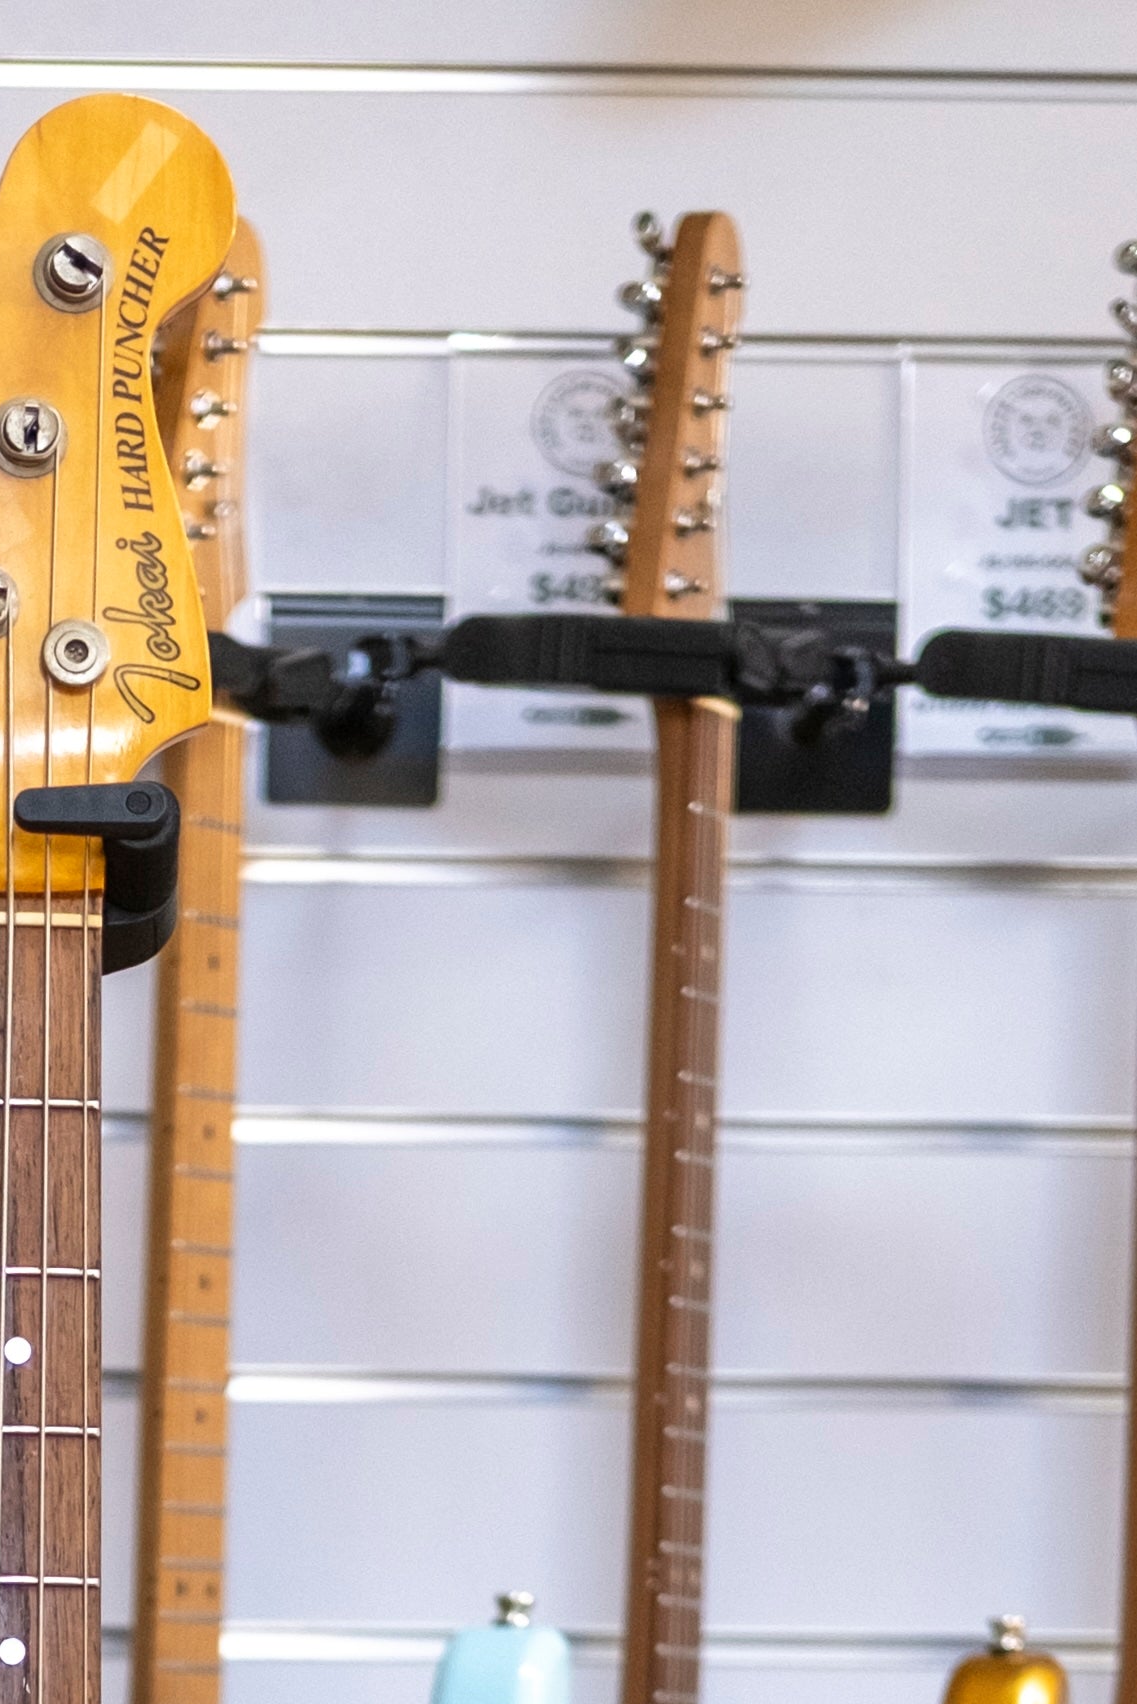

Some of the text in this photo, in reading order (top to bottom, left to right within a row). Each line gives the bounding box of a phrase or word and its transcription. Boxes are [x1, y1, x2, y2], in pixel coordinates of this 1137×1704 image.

[103, 226, 200, 724] Tokai HARD PUNCHER
[996, 498, 1074, 529] JET
